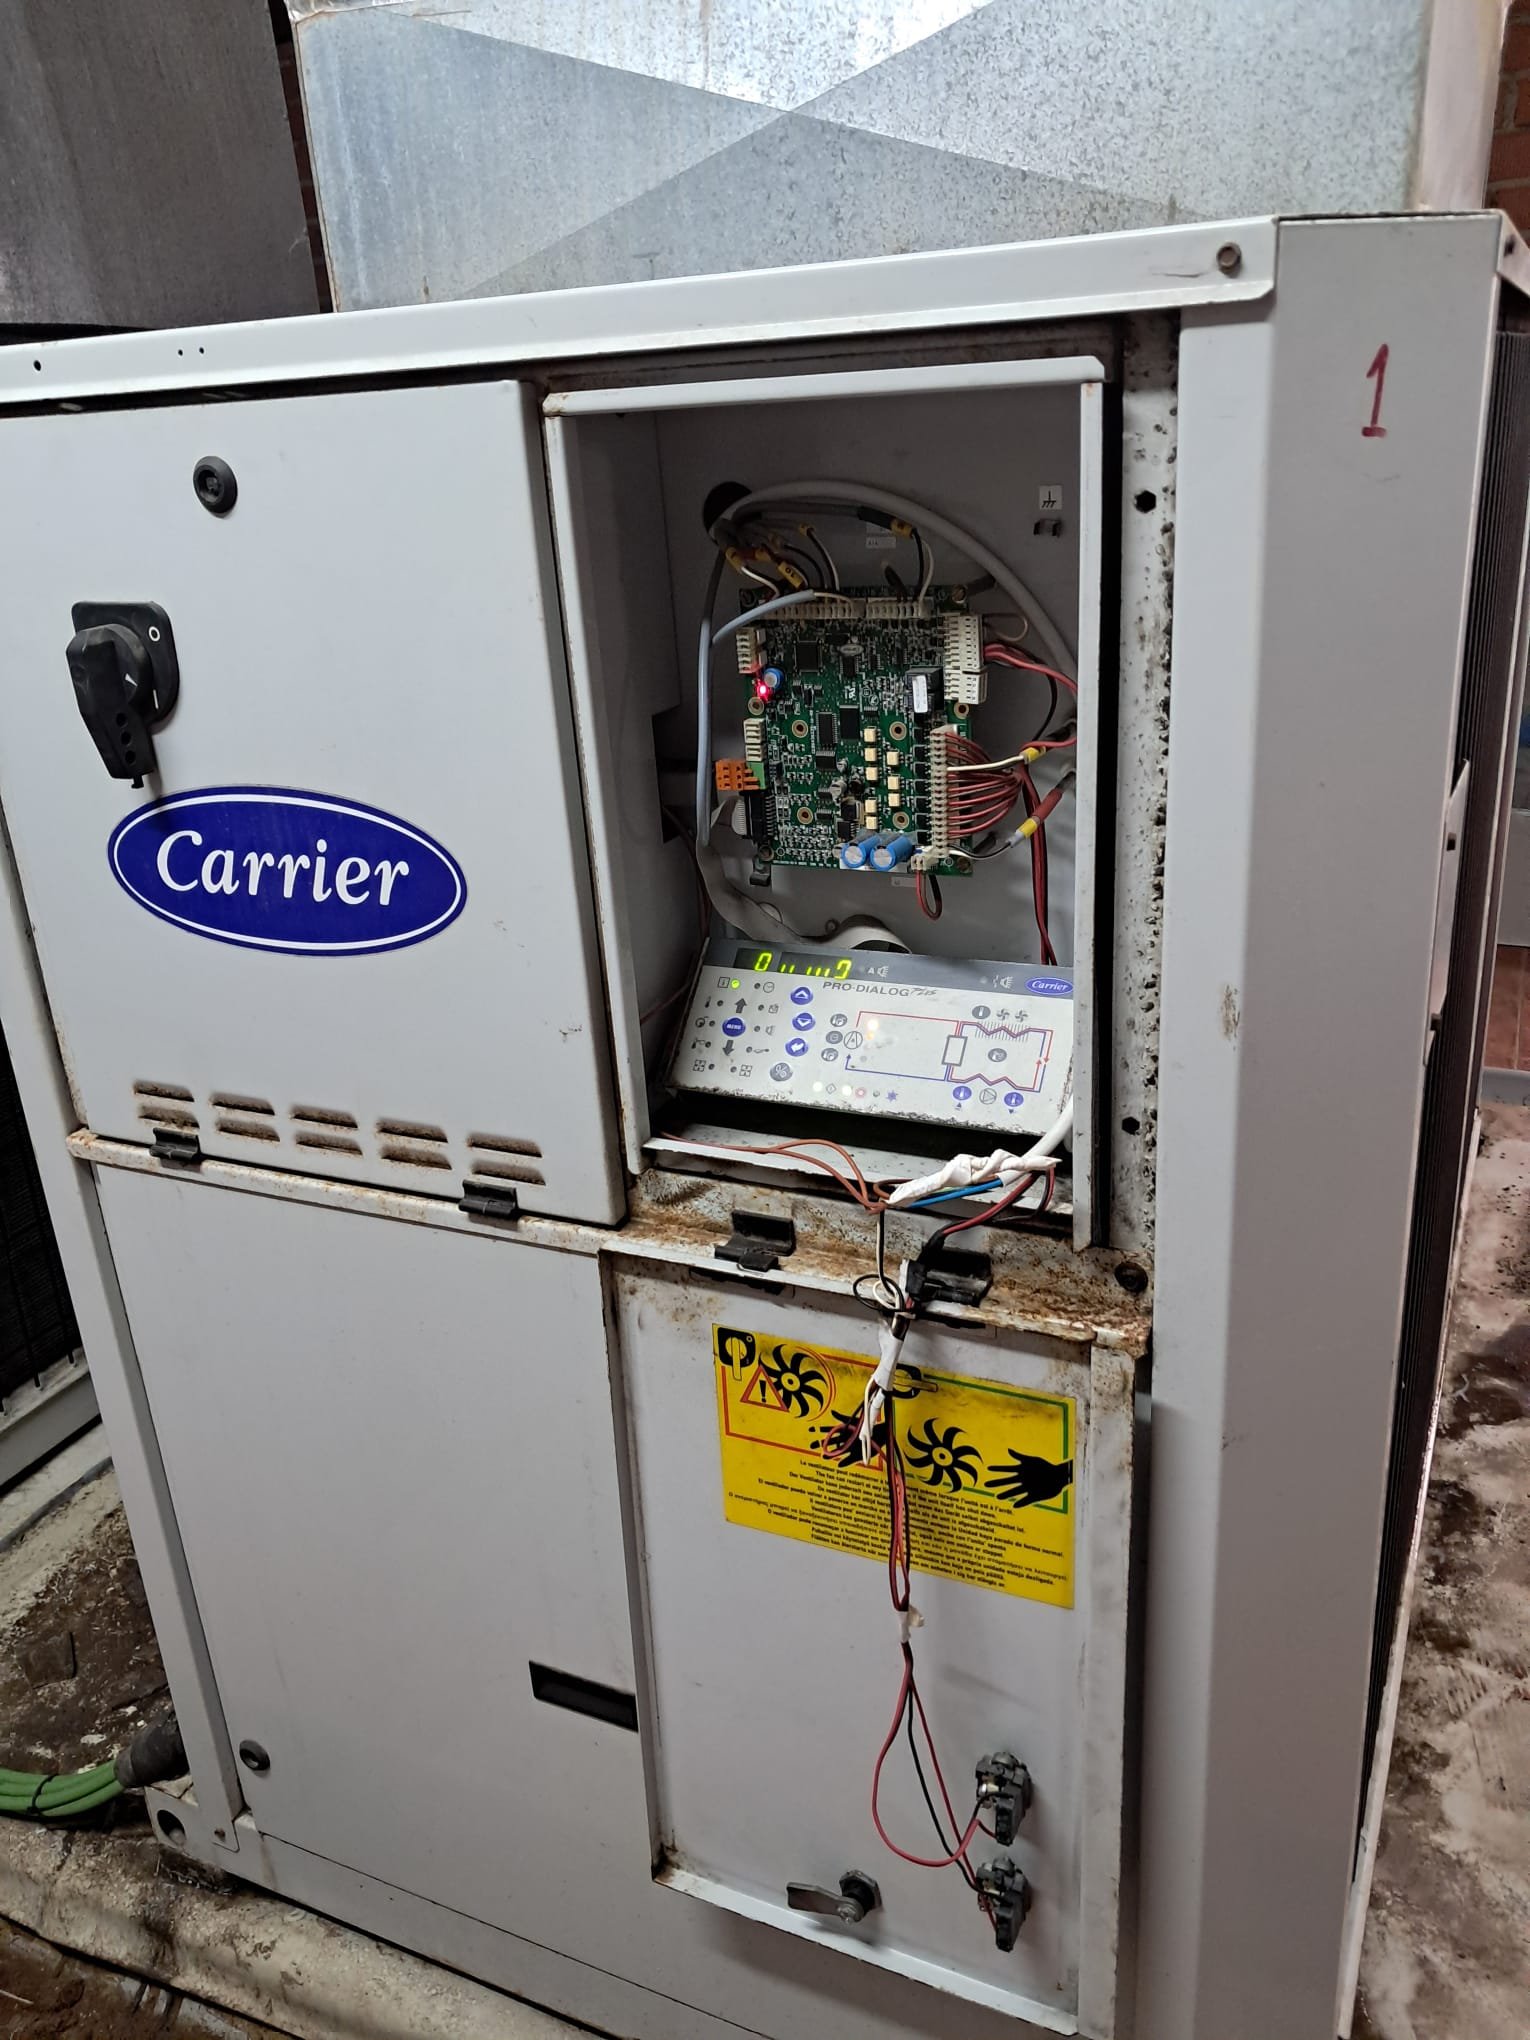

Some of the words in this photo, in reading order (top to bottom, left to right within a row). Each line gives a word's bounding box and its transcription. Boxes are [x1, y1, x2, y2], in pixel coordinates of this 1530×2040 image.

[1362, 343, 1389, 438] 1
[156, 829, 410, 906] Carrier
[1031, 980, 1069, 991] Carrier
